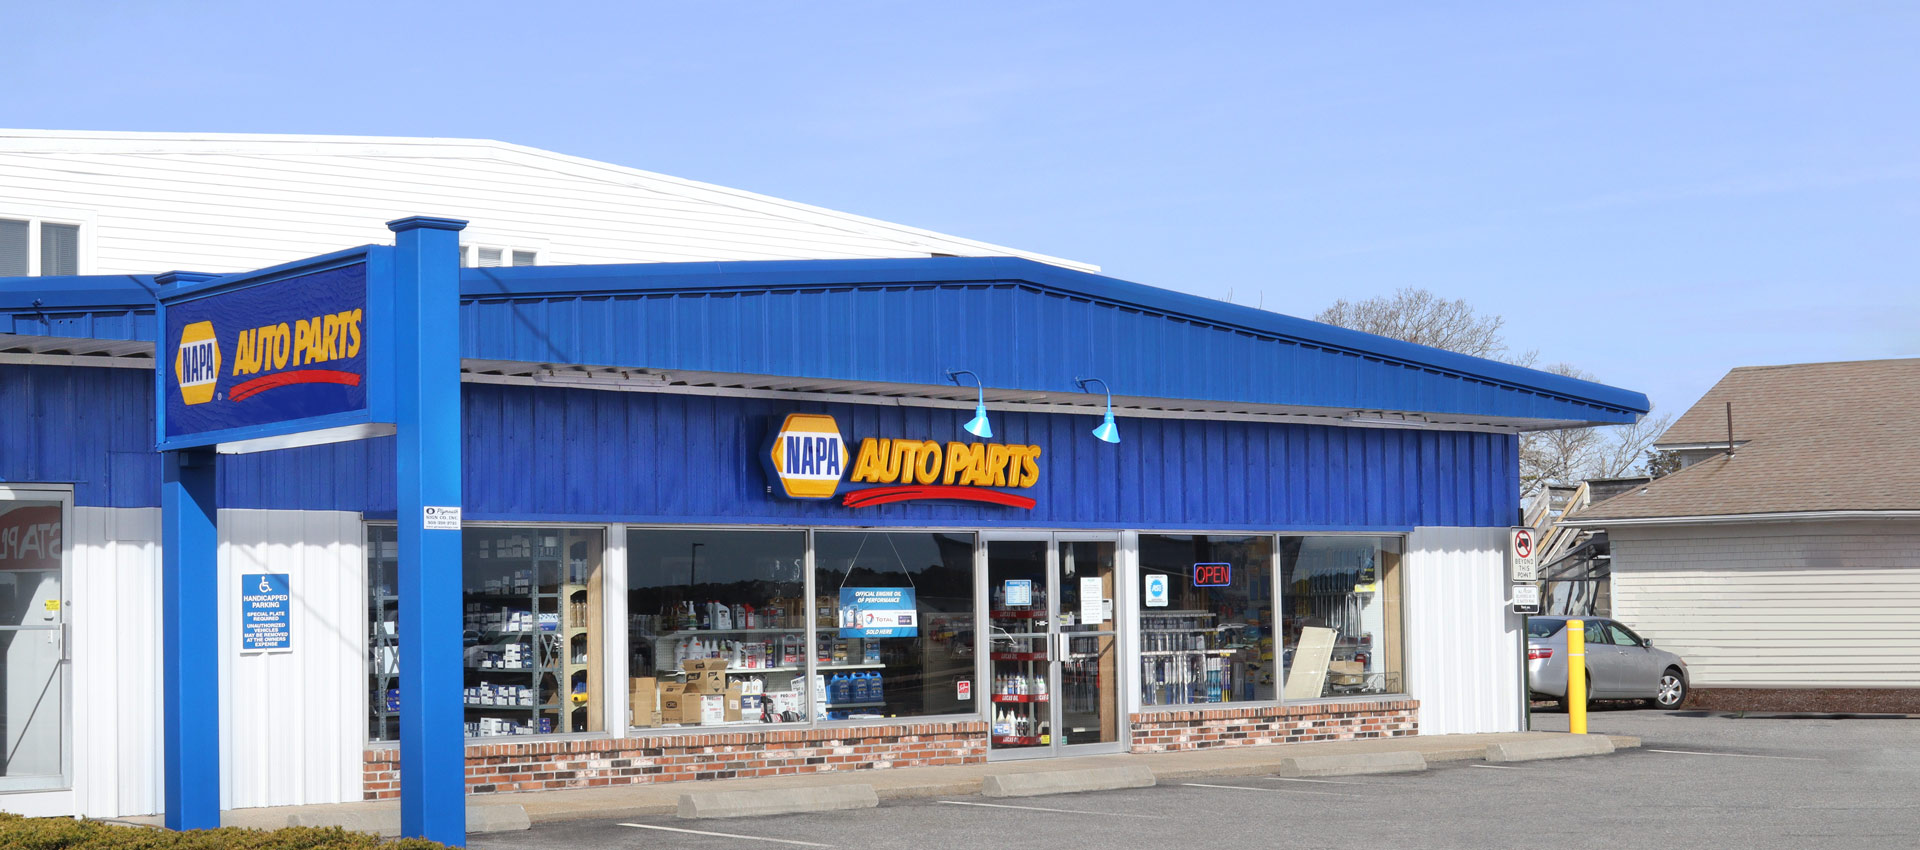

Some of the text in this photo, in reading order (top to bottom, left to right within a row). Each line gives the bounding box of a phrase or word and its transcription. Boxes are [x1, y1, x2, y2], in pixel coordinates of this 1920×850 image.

[232, 308, 362, 376] AUTO PARTS
[182, 342, 214, 384] NAPA
[786, 435, 840, 476] NAPA
[850, 437, 1041, 488] AUTO PARTS
[1195, 566, 1229, 584] OPEN
[243, 594, 289, 602] HANDICAPPED
